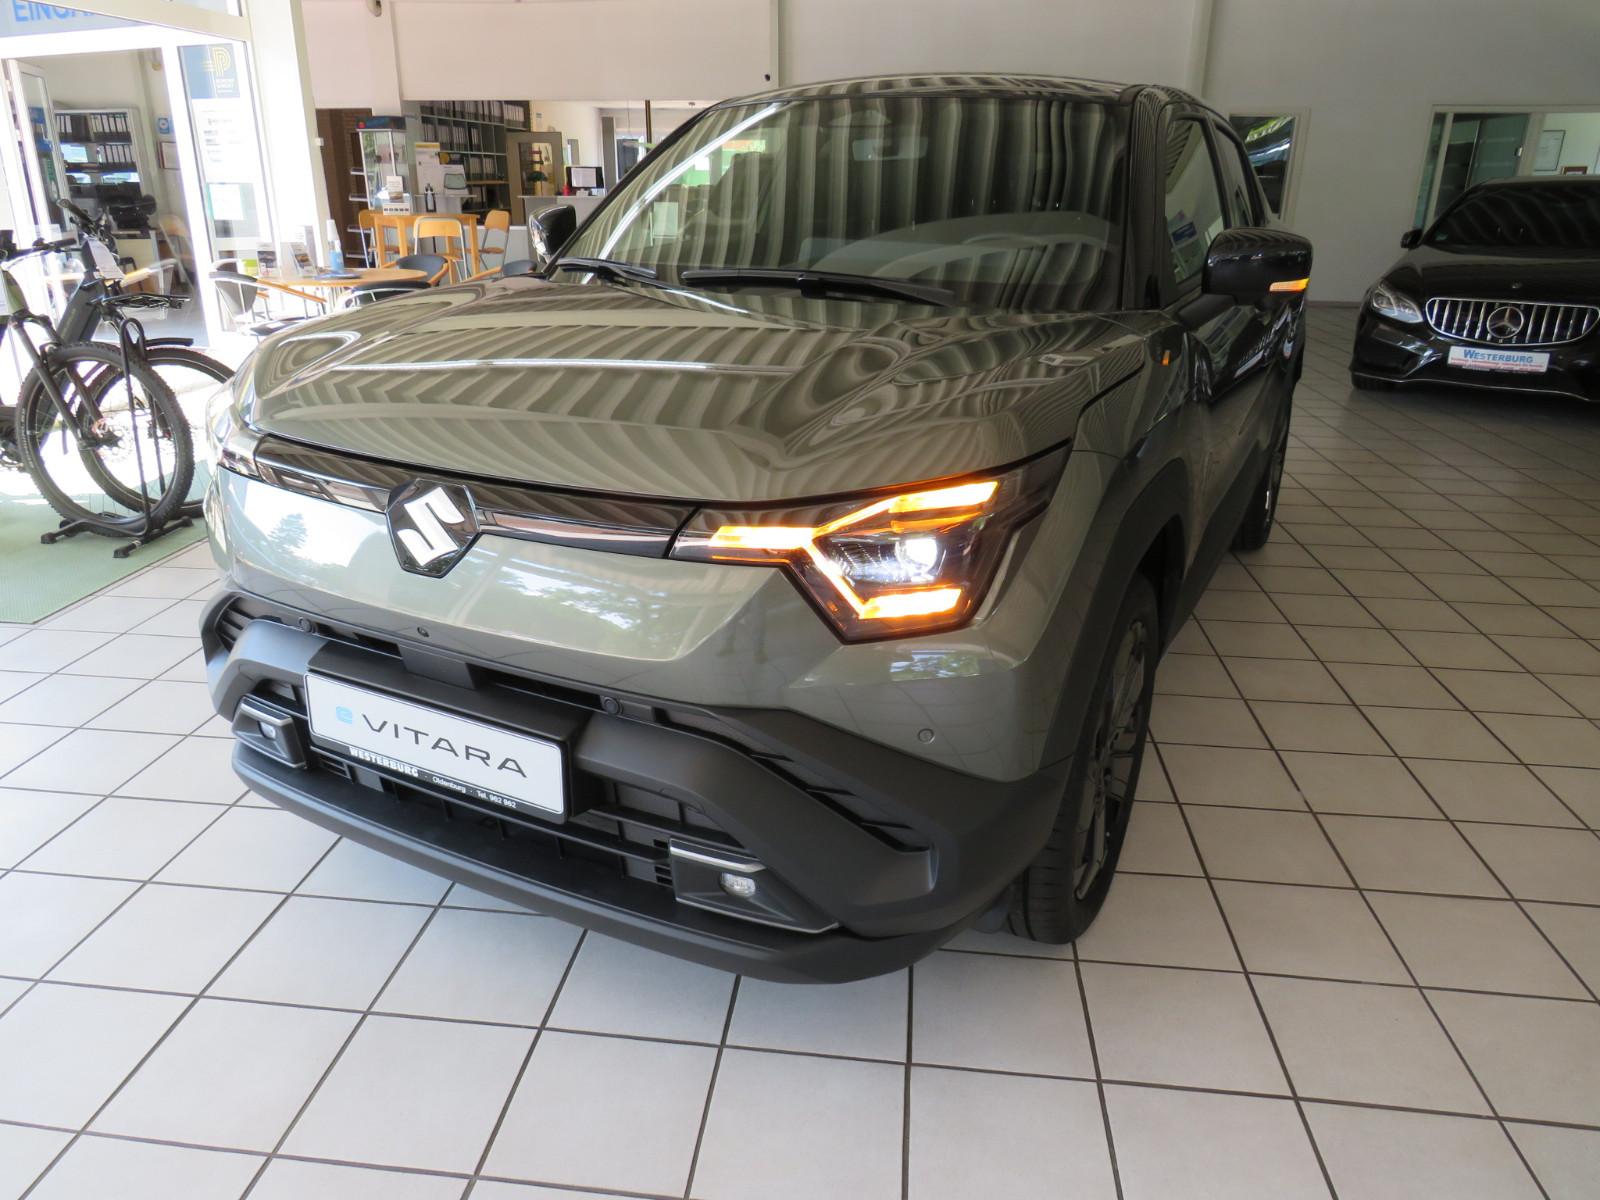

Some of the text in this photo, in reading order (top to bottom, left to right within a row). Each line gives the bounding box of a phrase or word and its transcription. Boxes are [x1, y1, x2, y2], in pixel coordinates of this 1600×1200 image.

[347, 745, 419, 777] WESTERBURG
[432, 776, 466, 794] Oldenburg
[477, 790, 489, 800] Tel.
[362, 713, 528, 779] VITARA
